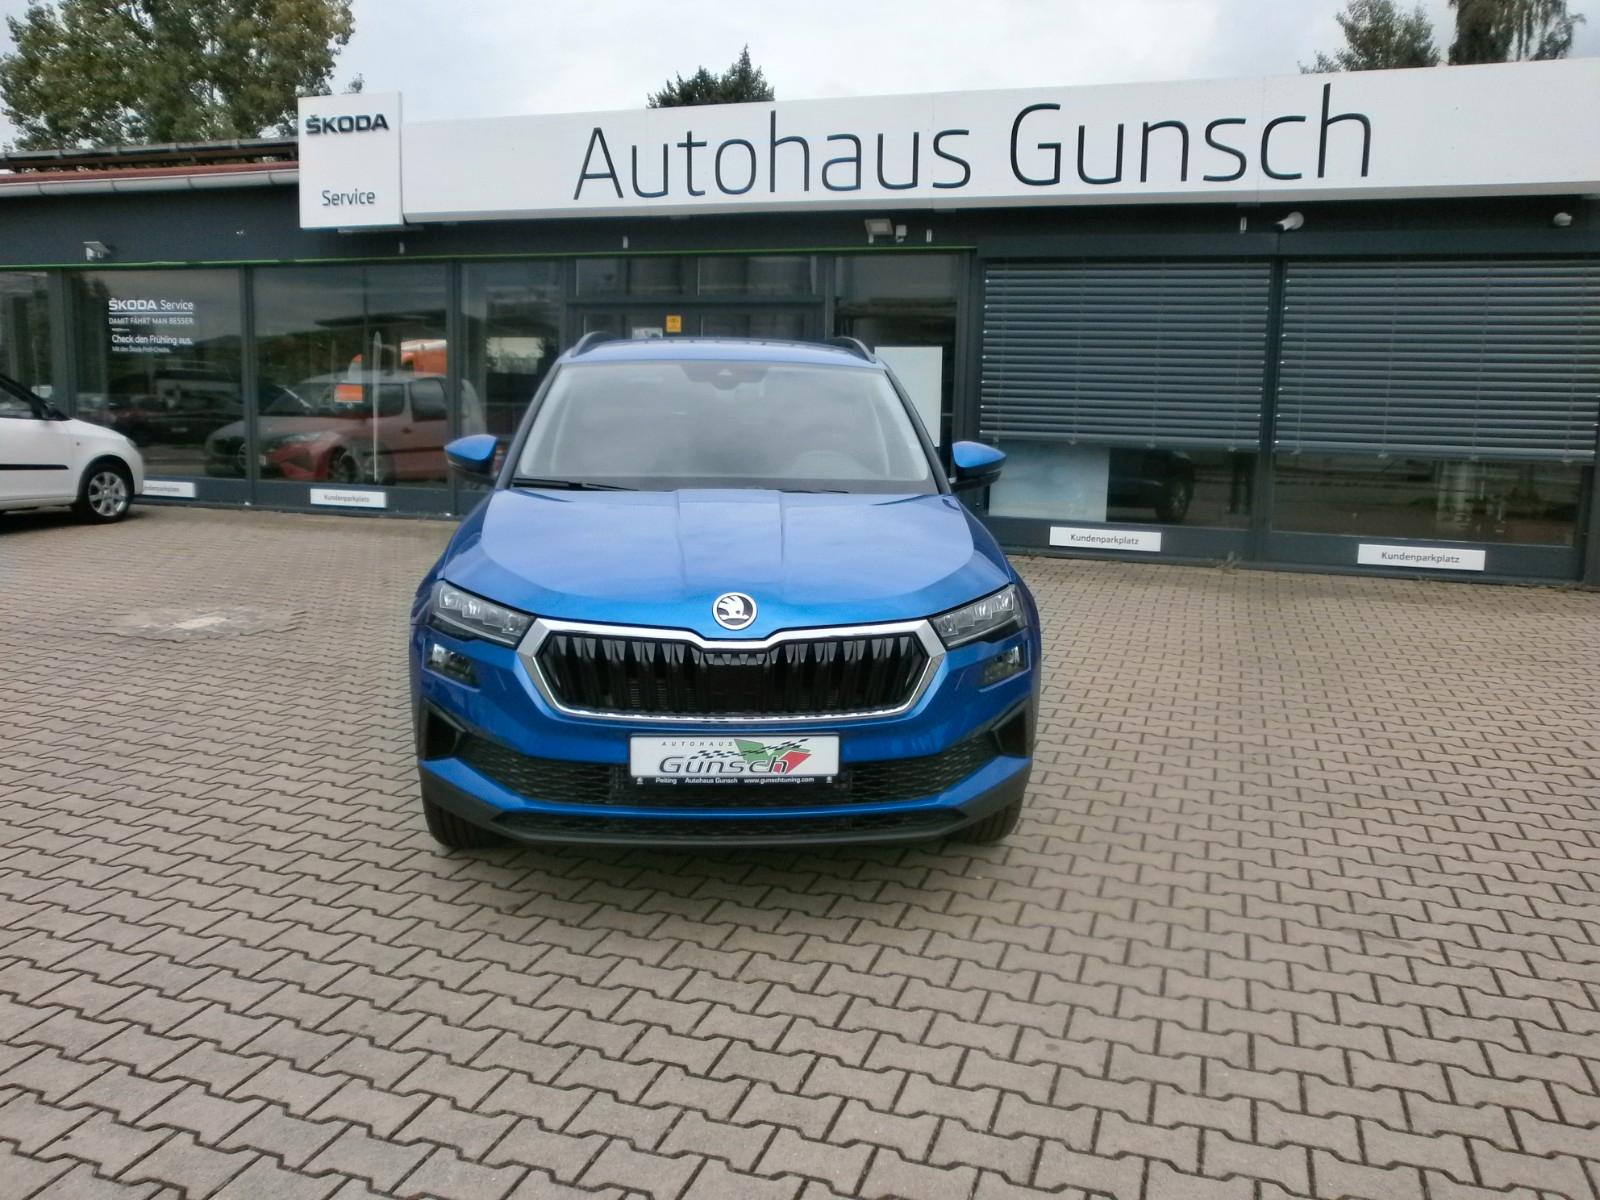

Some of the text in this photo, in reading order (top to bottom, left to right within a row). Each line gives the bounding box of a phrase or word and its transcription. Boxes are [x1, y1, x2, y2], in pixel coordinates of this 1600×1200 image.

[305, 114, 389, 134] ŠKODA
[573, 82, 1372, 201] Autohaus Gunsch
[322, 188, 376, 206] Service
[108, 297, 194, 311] ŠKODA Service
[108, 317, 128, 325] DAMIT
[152, 317, 168, 325] MAN
[111, 334, 133, 343] Check
[135, 334, 149, 343] den
[150, 334, 177, 346] Frühling
[1070, 533, 1140, 545] Kundenparkplatz
[1381, 551, 1461, 564] Kundenparkplatz
[659, 756, 788, 774] Gunsch
[743, 777, 815, 785] www.gunschtuning.com
